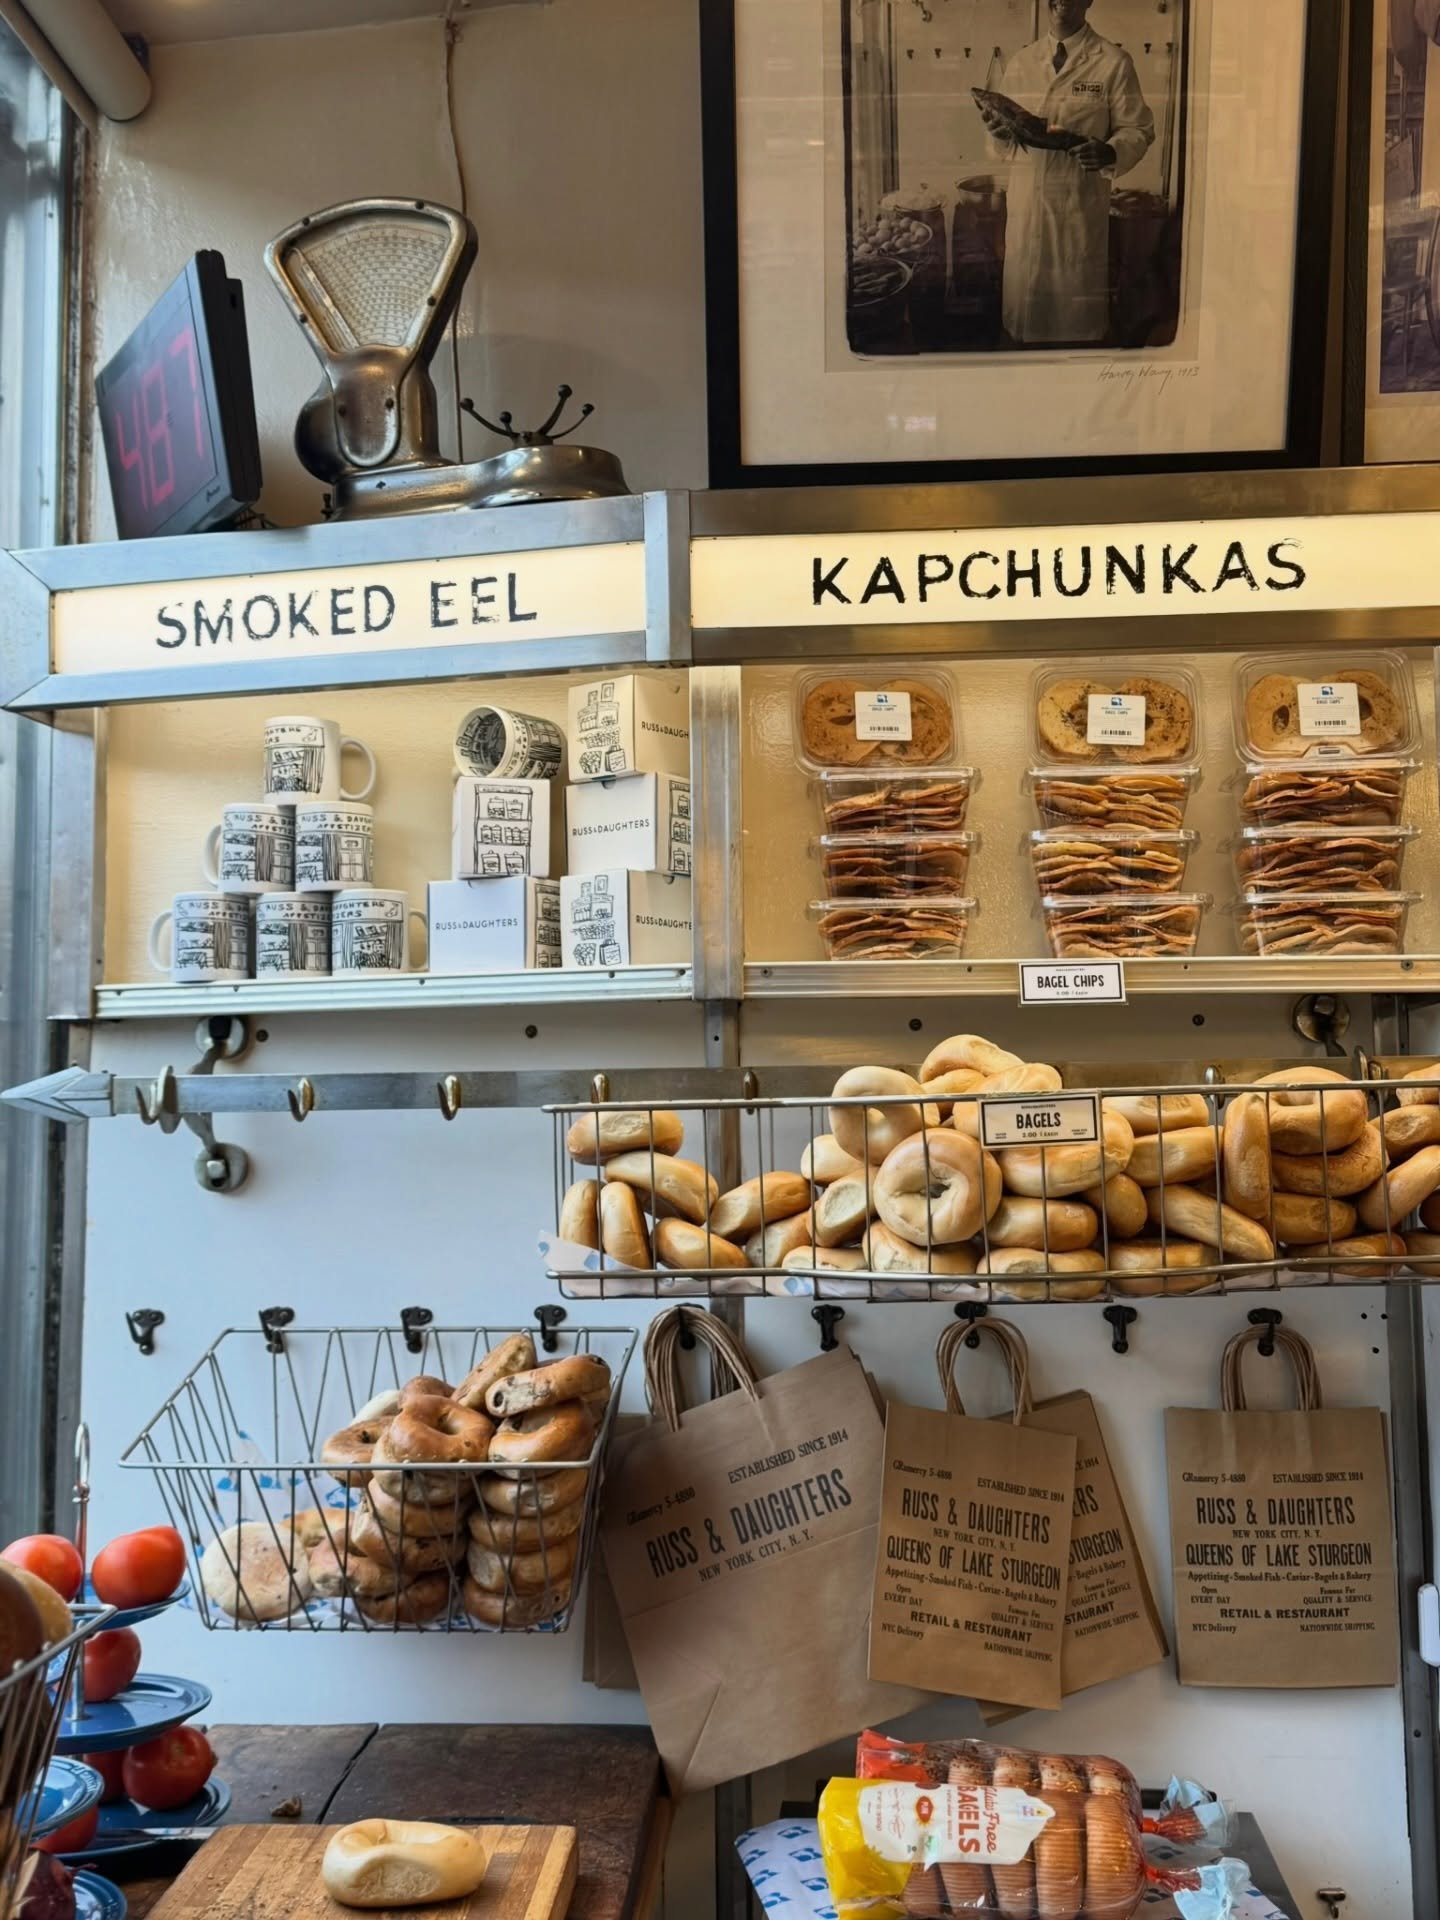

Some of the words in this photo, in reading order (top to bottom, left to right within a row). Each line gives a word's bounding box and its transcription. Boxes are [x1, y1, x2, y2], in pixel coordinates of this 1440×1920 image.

[813, 537, 1307, 606] KAPCHUNKAS
[156, 584, 396, 648] SMOKED
[430, 572, 538, 628] EEL
[572, 818, 651, 836] RUSS&DAUGHTERS
[435, 918, 518, 931] RUSS&DAUGHTERS
[1037, 975, 1069, 988] BAGEL
[1073, 974, 1104, 987] CHIPS
[1016, 1112, 1062, 1130] BAGELS
[728, 1450, 795, 1484] ESTABLISHED
[798, 1437, 827, 1457] SINCE
[828, 1429, 848, 1447] 1914
[1273, 1473, 1323, 1483] ESTABLISHED
[1326, 1473, 1346, 1482] SINCE
[1349, 1472, 1364, 1481] 1914
[977, 1477, 1026, 1496] ESTABLISHED
[1028, 1487, 1048, 1499] SINCE
[1050, 1491, 1065, 1502] 1914
[902, 1488, 939, 1522] RUSS
[948, 1498, 957, 1526] &
[968, 1502, 1050, 1544] DAUGHTERS
[1197, 1497, 1236, 1525] RUSS
[1247, 1499, 1257, 1525] &
[1268, 1497, 1355, 1525] DAUGHTERS
[646, 1526, 699, 1578] RUSS
[704, 1518, 726, 1554] &
[729, 1468, 851, 1545] DAUGHTERS
[933, 1528, 949, 1538] NEW
[954, 1530, 974, 1545] YORK
[1232, 1530, 1250, 1538] NEW
[1255, 1530, 1276, 1538] YORK
[1069, 1528, 1124, 1565] STURGEON
[1186, 1543, 1233, 1567] QUEENS
[1242, 1544, 1256, 1567] OF
[1266, 1544, 1300, 1567] LAKE
[1309, 1543, 1372, 1567] STURGEON
[699, 1563, 721, 1582] NEW
[725, 1552, 755, 1571] YORK
[887, 1535, 931, 1565] QUEENS
[940, 1545, 954, 1569] OF
[963, 1548, 994, 1578] LAKE
[1002, 1555, 1061, 1591] STURGEON
[958, 1577, 973, 1591] Fish
[1265, 1572, 1281, 1581] Fish
[884, 1592, 906, 1605] EVERY
[909, 1597, 923, 1607] DAY
[1201, 1586, 1217, 1595] Open
[1191, 1596, 1213, 1604] EVERY
[1217, 1596, 1230, 1604] DAY
[1303, 1596, 1333, 1605] QUALITY
[1345, 1595, 1372, 1603] SERVICE
[1220, 1608, 1261, 1618] RETAIL
[1277, 1608, 1349, 1618] RESTAURANT
[882, 1623, 896, 1633] NYC
[897, 1625, 924, 1640] Delivery
[911, 1611, 949, 1627] RETAIL
[953, 1619, 960, 1629] &
[965, 1620, 1032, 1643] RESTAURANT
[1193, 1624, 1207, 1632] NYC
[1208, 1624, 1237, 1634] Delivery
[1300, 1624, 1343, 1632] NATIONWIDE
[1345, 1623, 1375, 1631] SHIPPING
[957, 1786, 981, 1854] BAGELS
[986, 1812, 1001, 1854] Free
